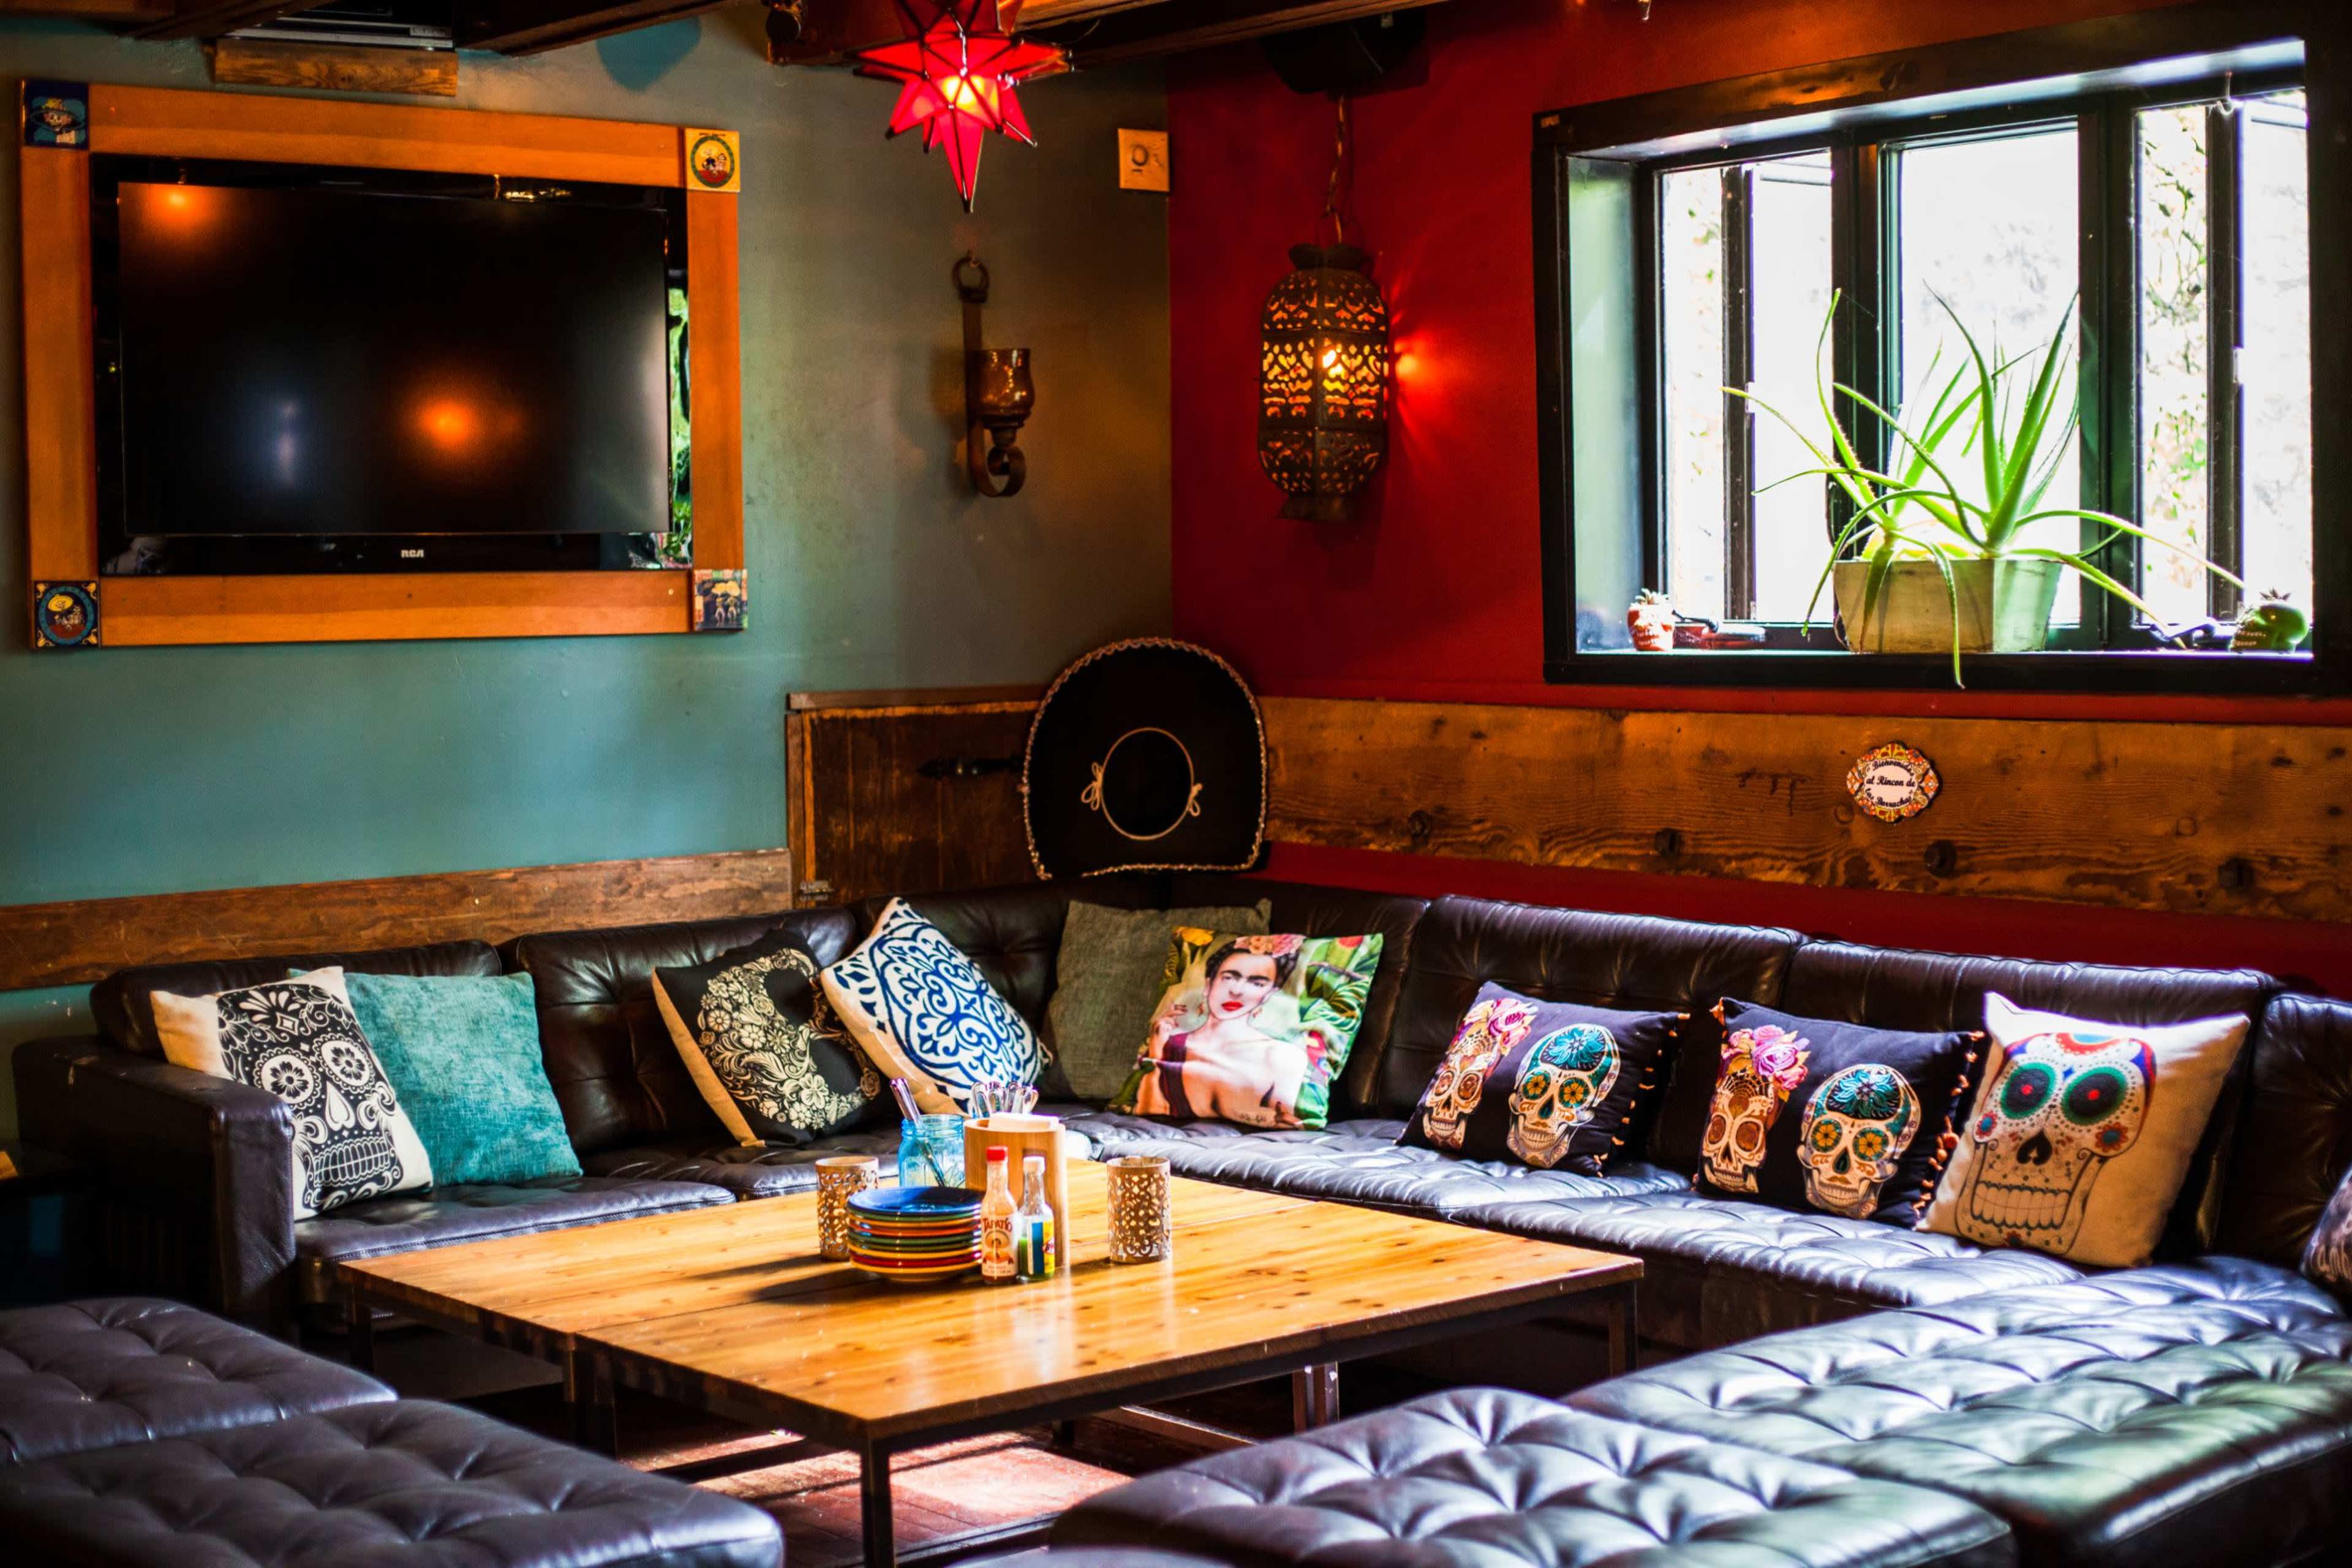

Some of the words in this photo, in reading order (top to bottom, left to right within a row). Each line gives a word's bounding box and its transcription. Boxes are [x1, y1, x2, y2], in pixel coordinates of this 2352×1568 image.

[401, 549, 424, 558] RCA
[1866, 775, 1875, 784] al
[1906, 778, 1915, 786] de
